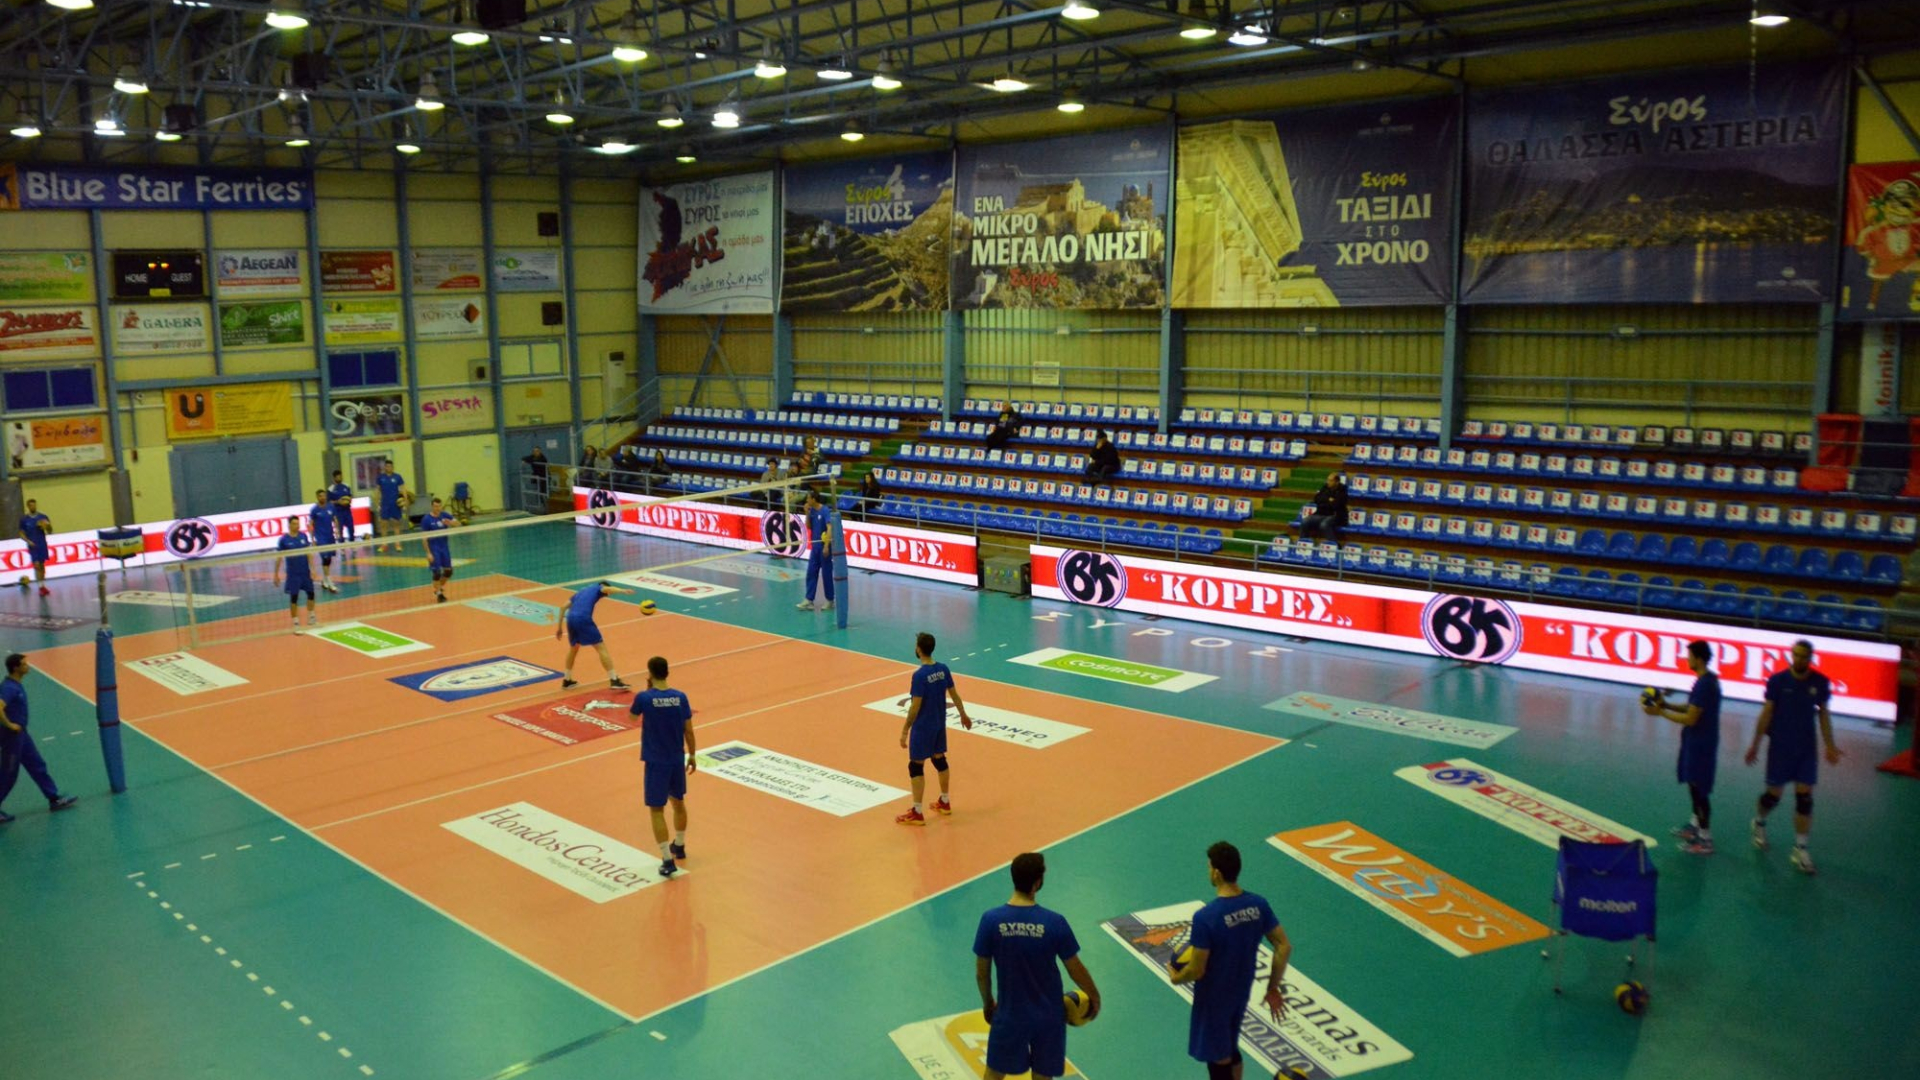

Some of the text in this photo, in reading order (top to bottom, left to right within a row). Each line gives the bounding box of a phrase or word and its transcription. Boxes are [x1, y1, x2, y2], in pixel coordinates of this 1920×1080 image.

[1487, 114, 1816, 165] ΘΑΛΑΣΣΑ ΑΣΤΕΡΙΑ
[26, 172, 302, 202] Blue Star Ferries
[685, 205, 720, 224] ΣΥΡΟΣ
[845, 201, 914, 225] ΕΠΟΧΕΣ
[974, 196, 1004, 213] ΕΝΑ
[1336, 194, 1431, 223] ΤΑΞΙΔΙ
[973, 213, 1038, 237] ΜΙΚΡΟ
[1365, 226, 1399, 238] ΣΤΟ
[971, 231, 1149, 266] ΜΕΓΑΛΟ ΝΗΣΙ
[1336, 240, 1429, 265] ΧΡΟΝΟ
[240, 256, 297, 270] AEGEAN
[124, 273, 148, 284] HOME
[1578, 896, 1638, 913] molten
[998, 922, 1045, 934] SYROS
